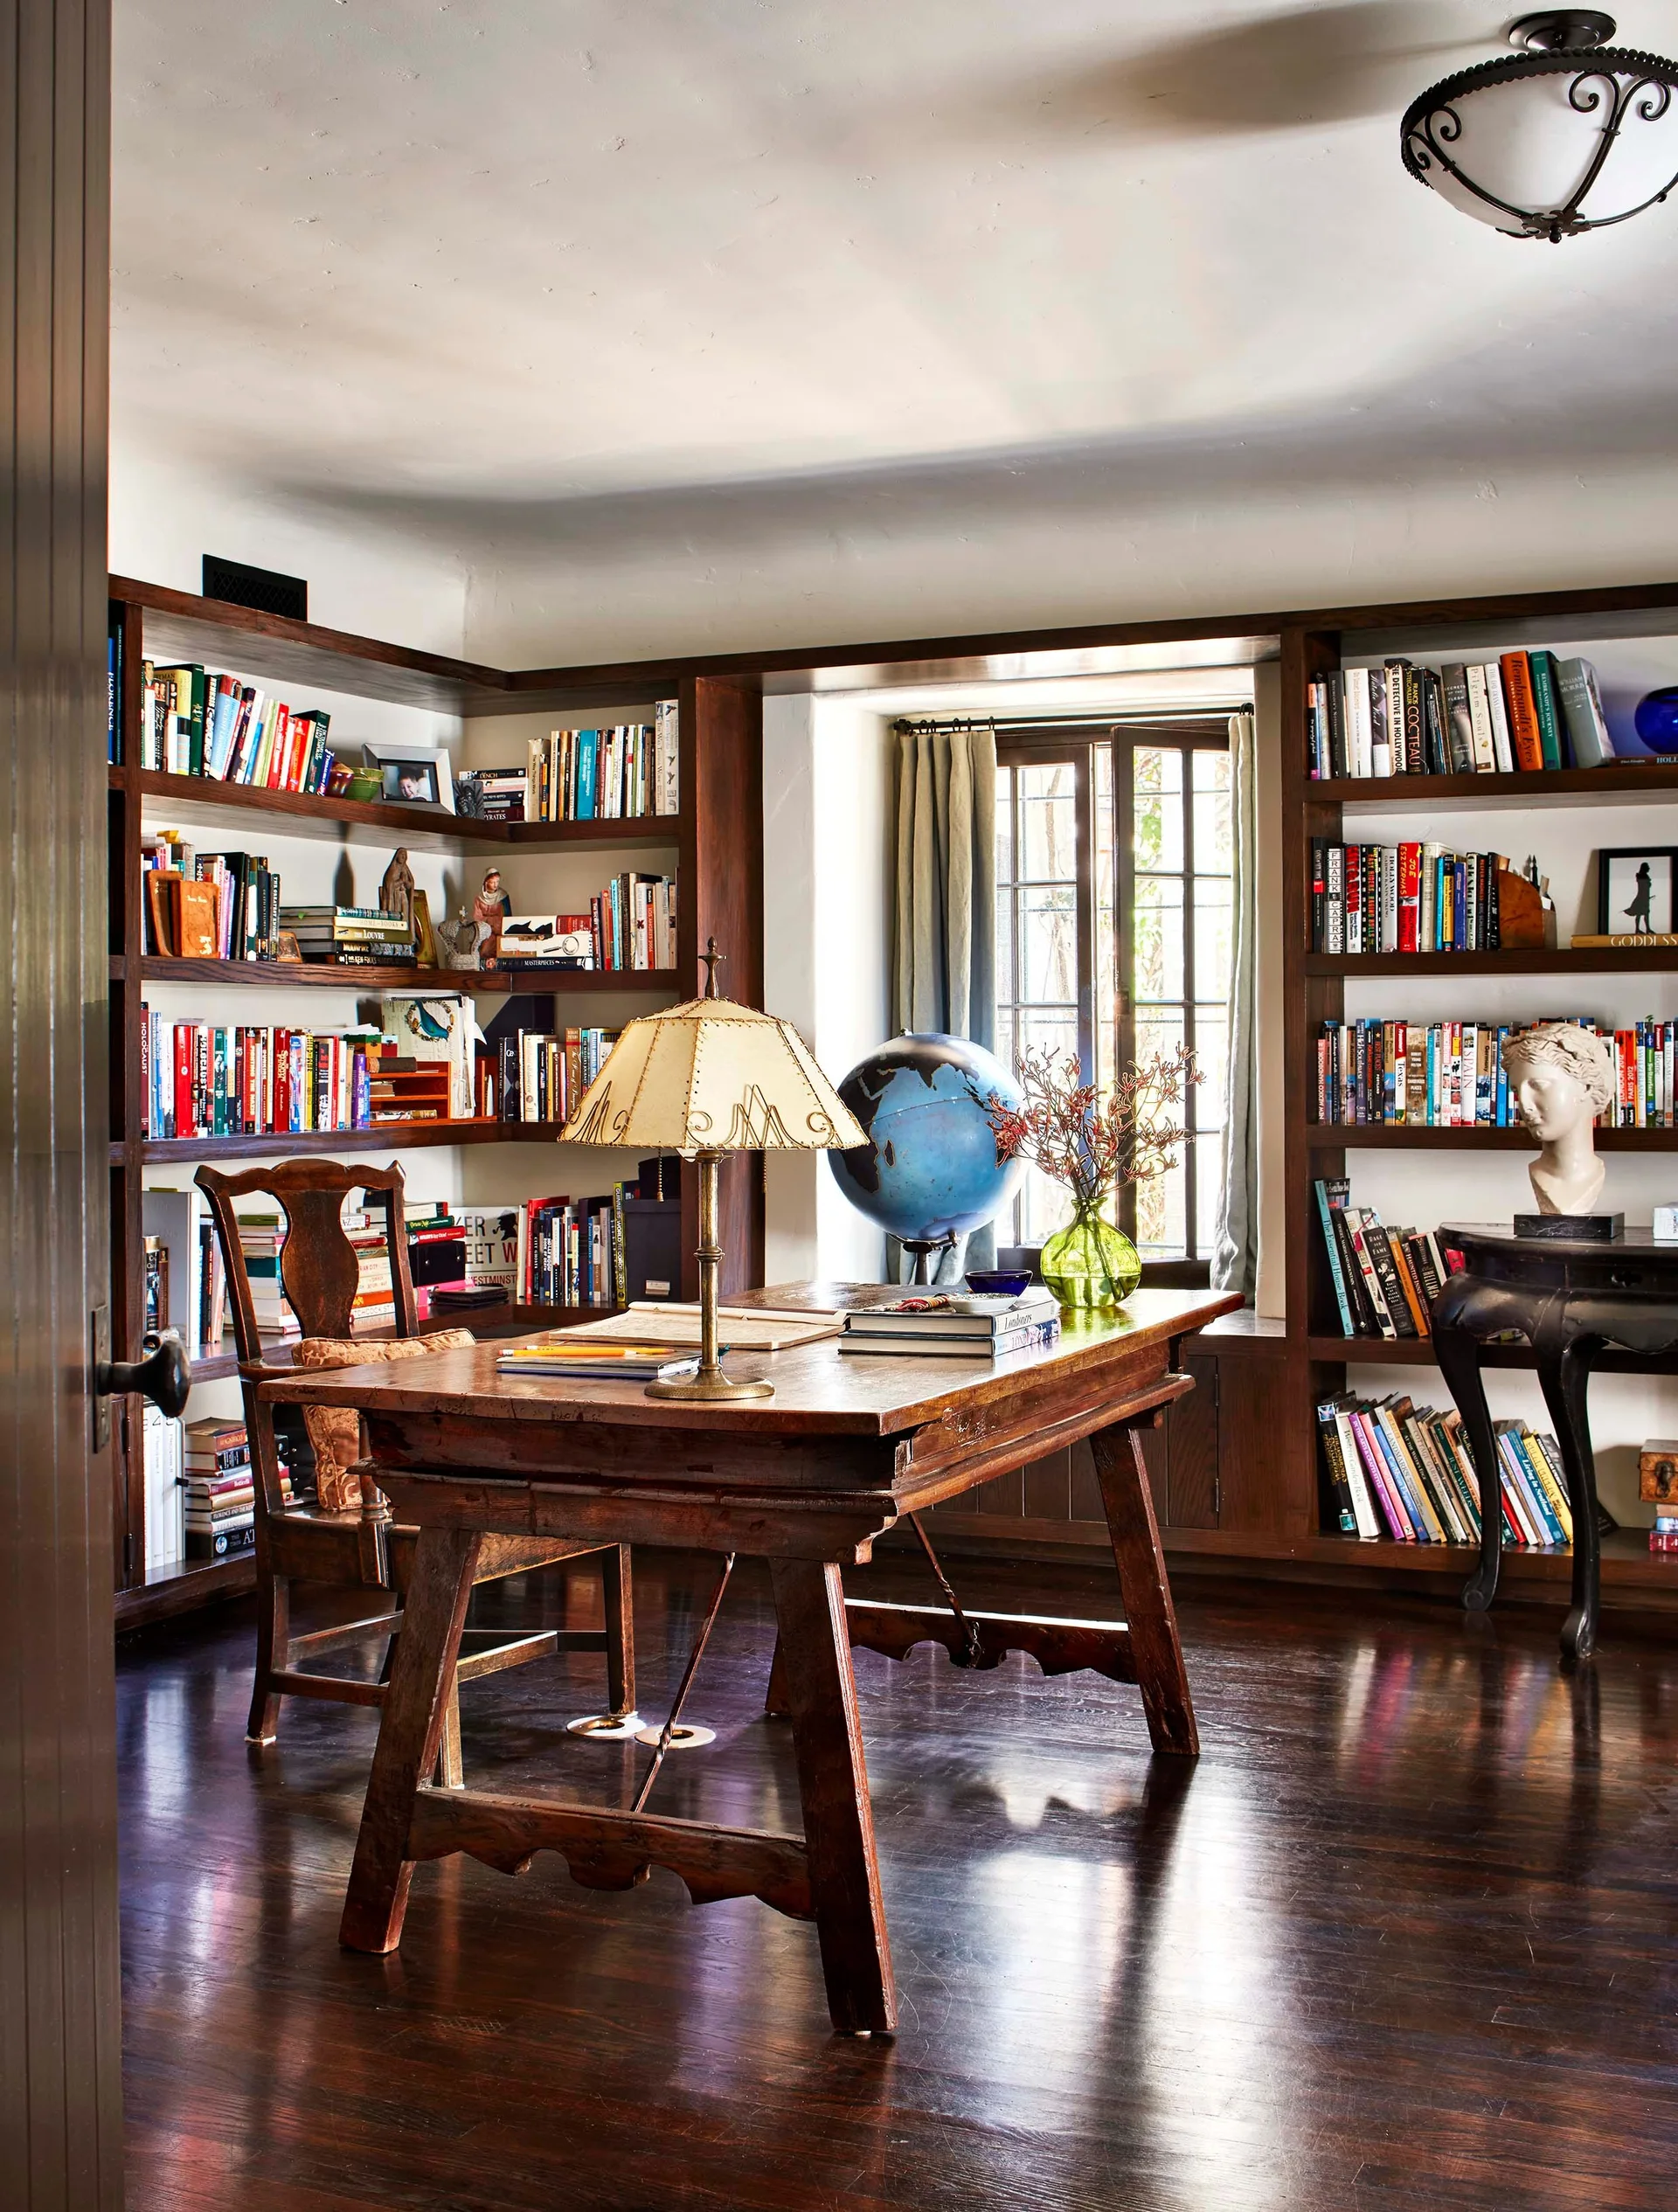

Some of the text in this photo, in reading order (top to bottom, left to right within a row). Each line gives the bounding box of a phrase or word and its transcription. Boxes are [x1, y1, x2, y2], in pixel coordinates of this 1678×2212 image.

[1393, 678, 1402, 715] DETECTIVE
[1470, 668, 1485, 741] Pilgrim Souls
[1512, 659, 1535, 764] Rembrandt's Eyes
[1542, 673, 1550, 711] REMBRANDT'S
[1407, 706, 1420, 765] COCTEAU
[364, 930, 385, 940] LOUVRE
[1397, 1061, 1405, 1087] Texas
[1463, 1051, 1473, 1089] SPAIN
[1323, 1218, 1347, 1311] The Essential House Book
[1405, 1253, 1418, 1279] HAUNTED
[1005, 1314, 1032, 1330] Londoners
[1344, 1430, 1363, 1503] Western Garden Book
[1364, 1453, 1376, 1472] CRAFTS
[1372, 1472, 1382, 1489] STYLE
[1387, 1432, 1409, 1477] LANDMARKS
[1409, 1451, 1421, 1468] WATER'S
[1413, 1430, 1442, 1488] COTTAGE GARDEN
[1388, 1456, 1414, 1512] Caribbean Elegance
[1448, 1456, 1473, 1507] JUST WEEDS
[1522, 1459, 1536, 1480] Living
[1535, 1487, 1552, 1515] Scotland
